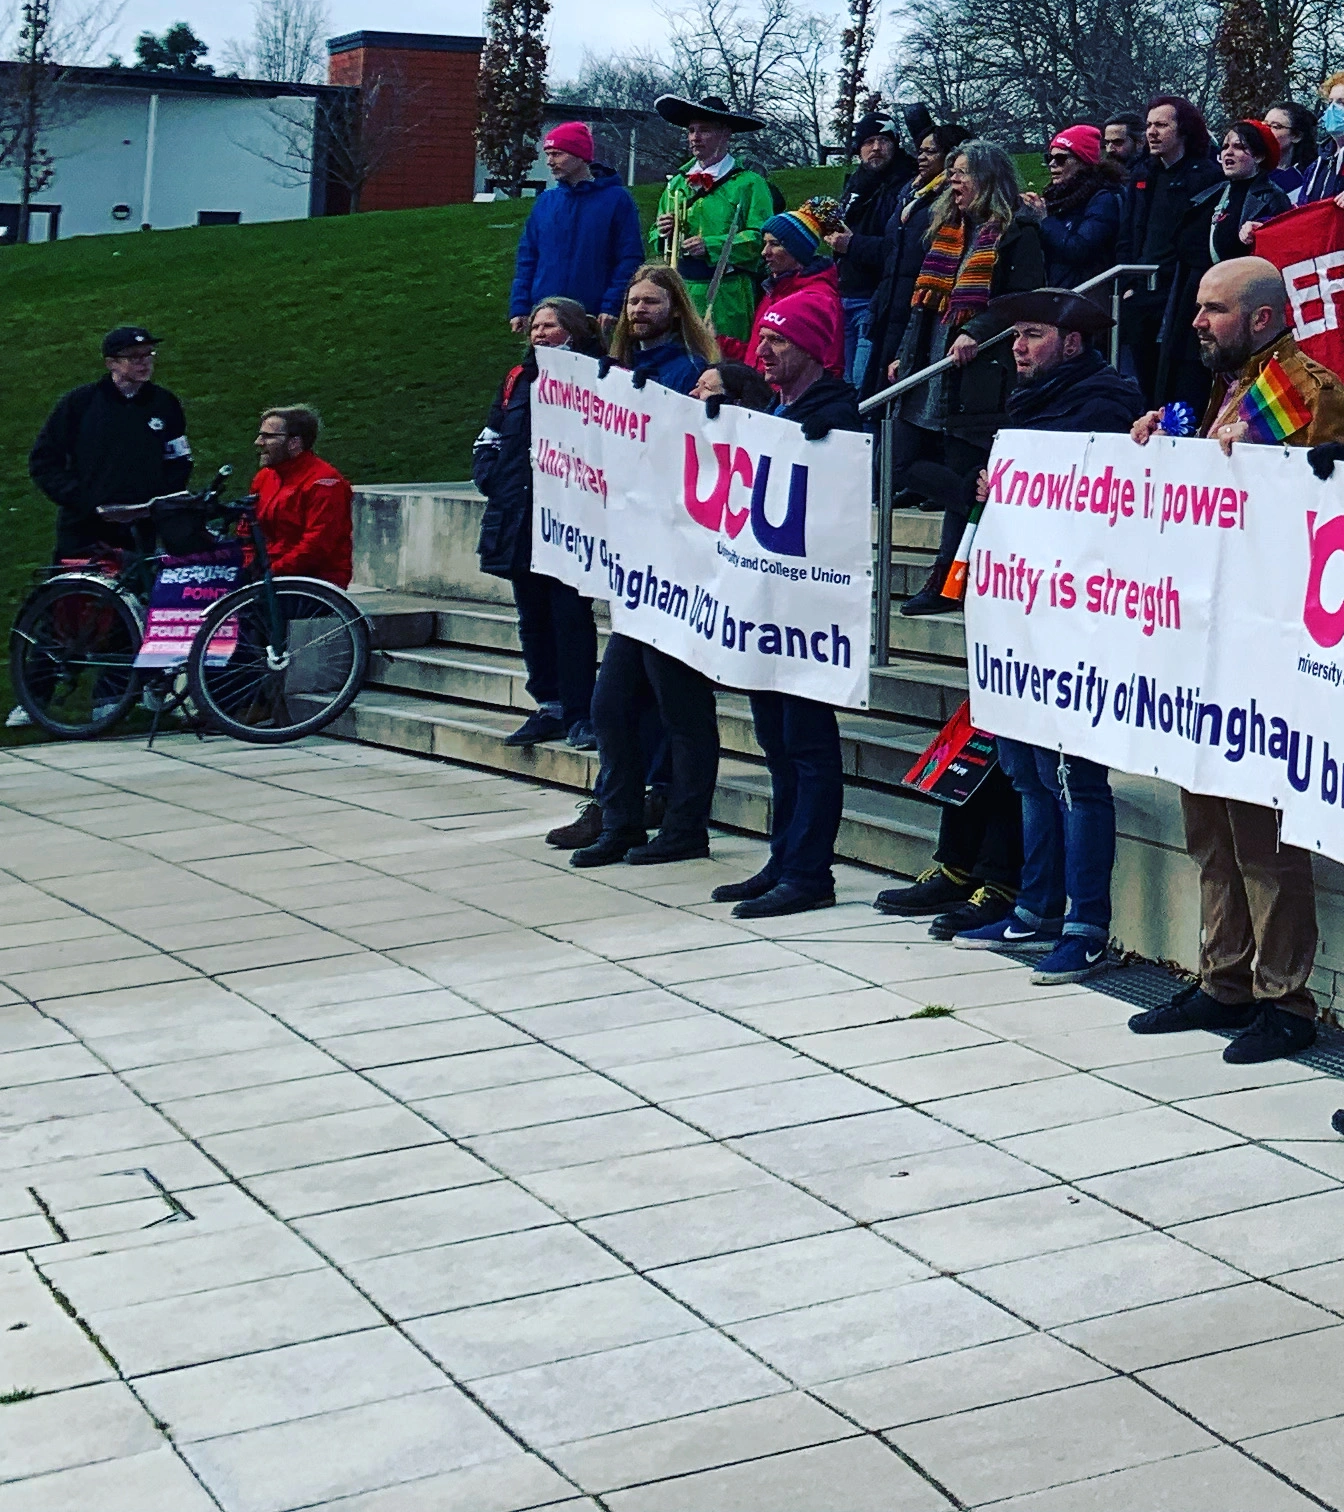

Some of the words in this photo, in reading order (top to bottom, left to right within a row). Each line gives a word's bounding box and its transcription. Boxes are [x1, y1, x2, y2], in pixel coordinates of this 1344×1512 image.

[684, 433, 809, 557] UCU
[987, 458, 1134, 527] Knowledge
[1159, 482, 1249, 534] power
[740, 557, 758, 570] and
[760, 559, 807, 581] College
[812, 567, 851, 585] Union
[975, 549, 1044, 615] Unity
[1049, 559, 1076, 609] is
[689, 585, 718, 641] UCU
[722, 605, 850, 668] branch
[974, 642, 1108, 729] University
[1298, 654, 1342, 688] niversity
